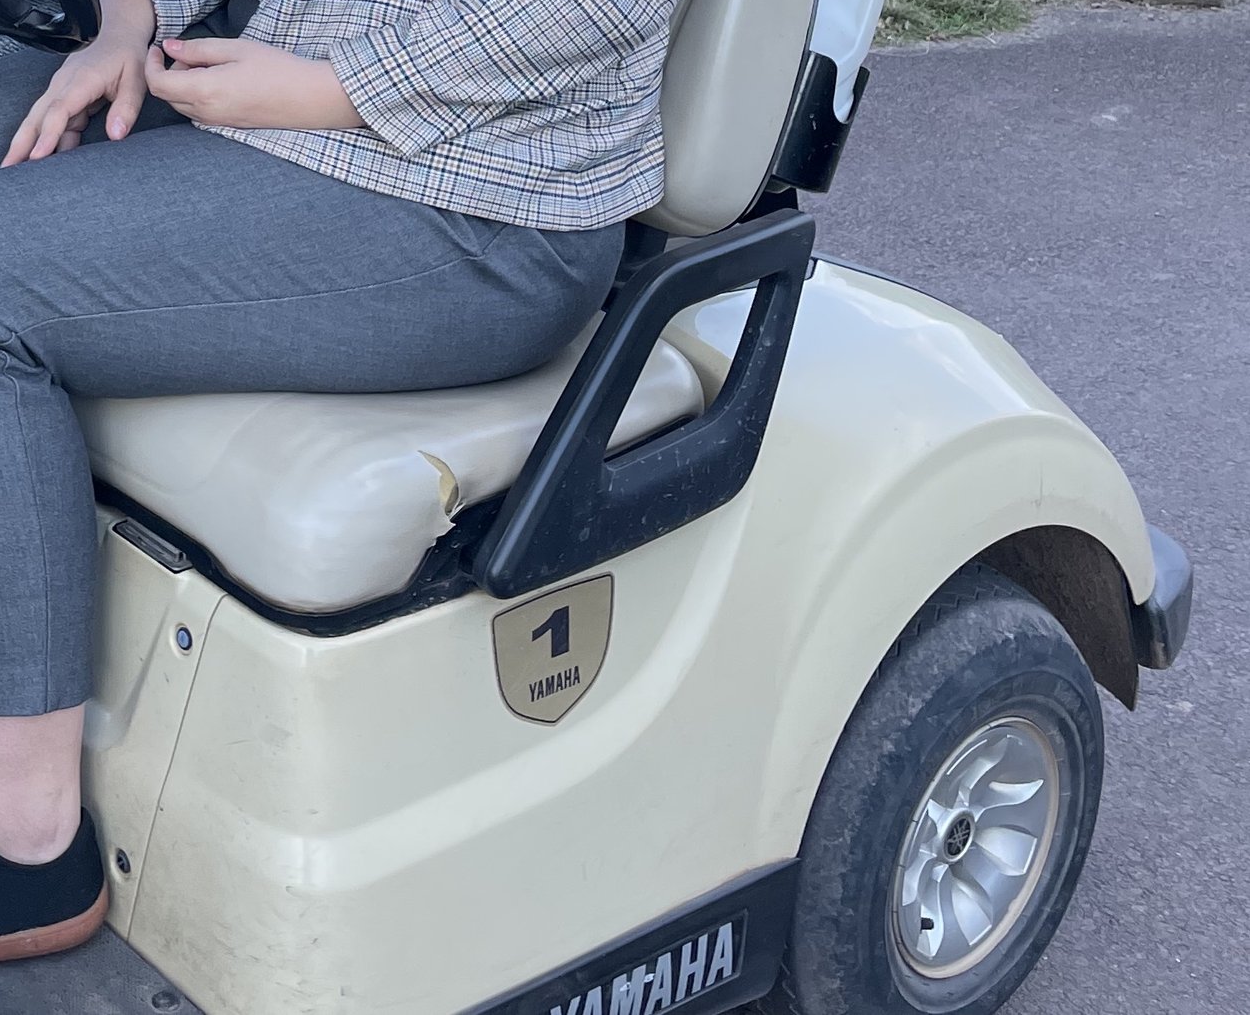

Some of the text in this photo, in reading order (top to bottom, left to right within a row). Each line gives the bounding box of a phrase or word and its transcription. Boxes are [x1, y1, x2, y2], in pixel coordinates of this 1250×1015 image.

[531, 605, 570, 658] 1
[529, 665, 581, 703] YAMAHA
[551, 922, 733, 1015] AMAHA
